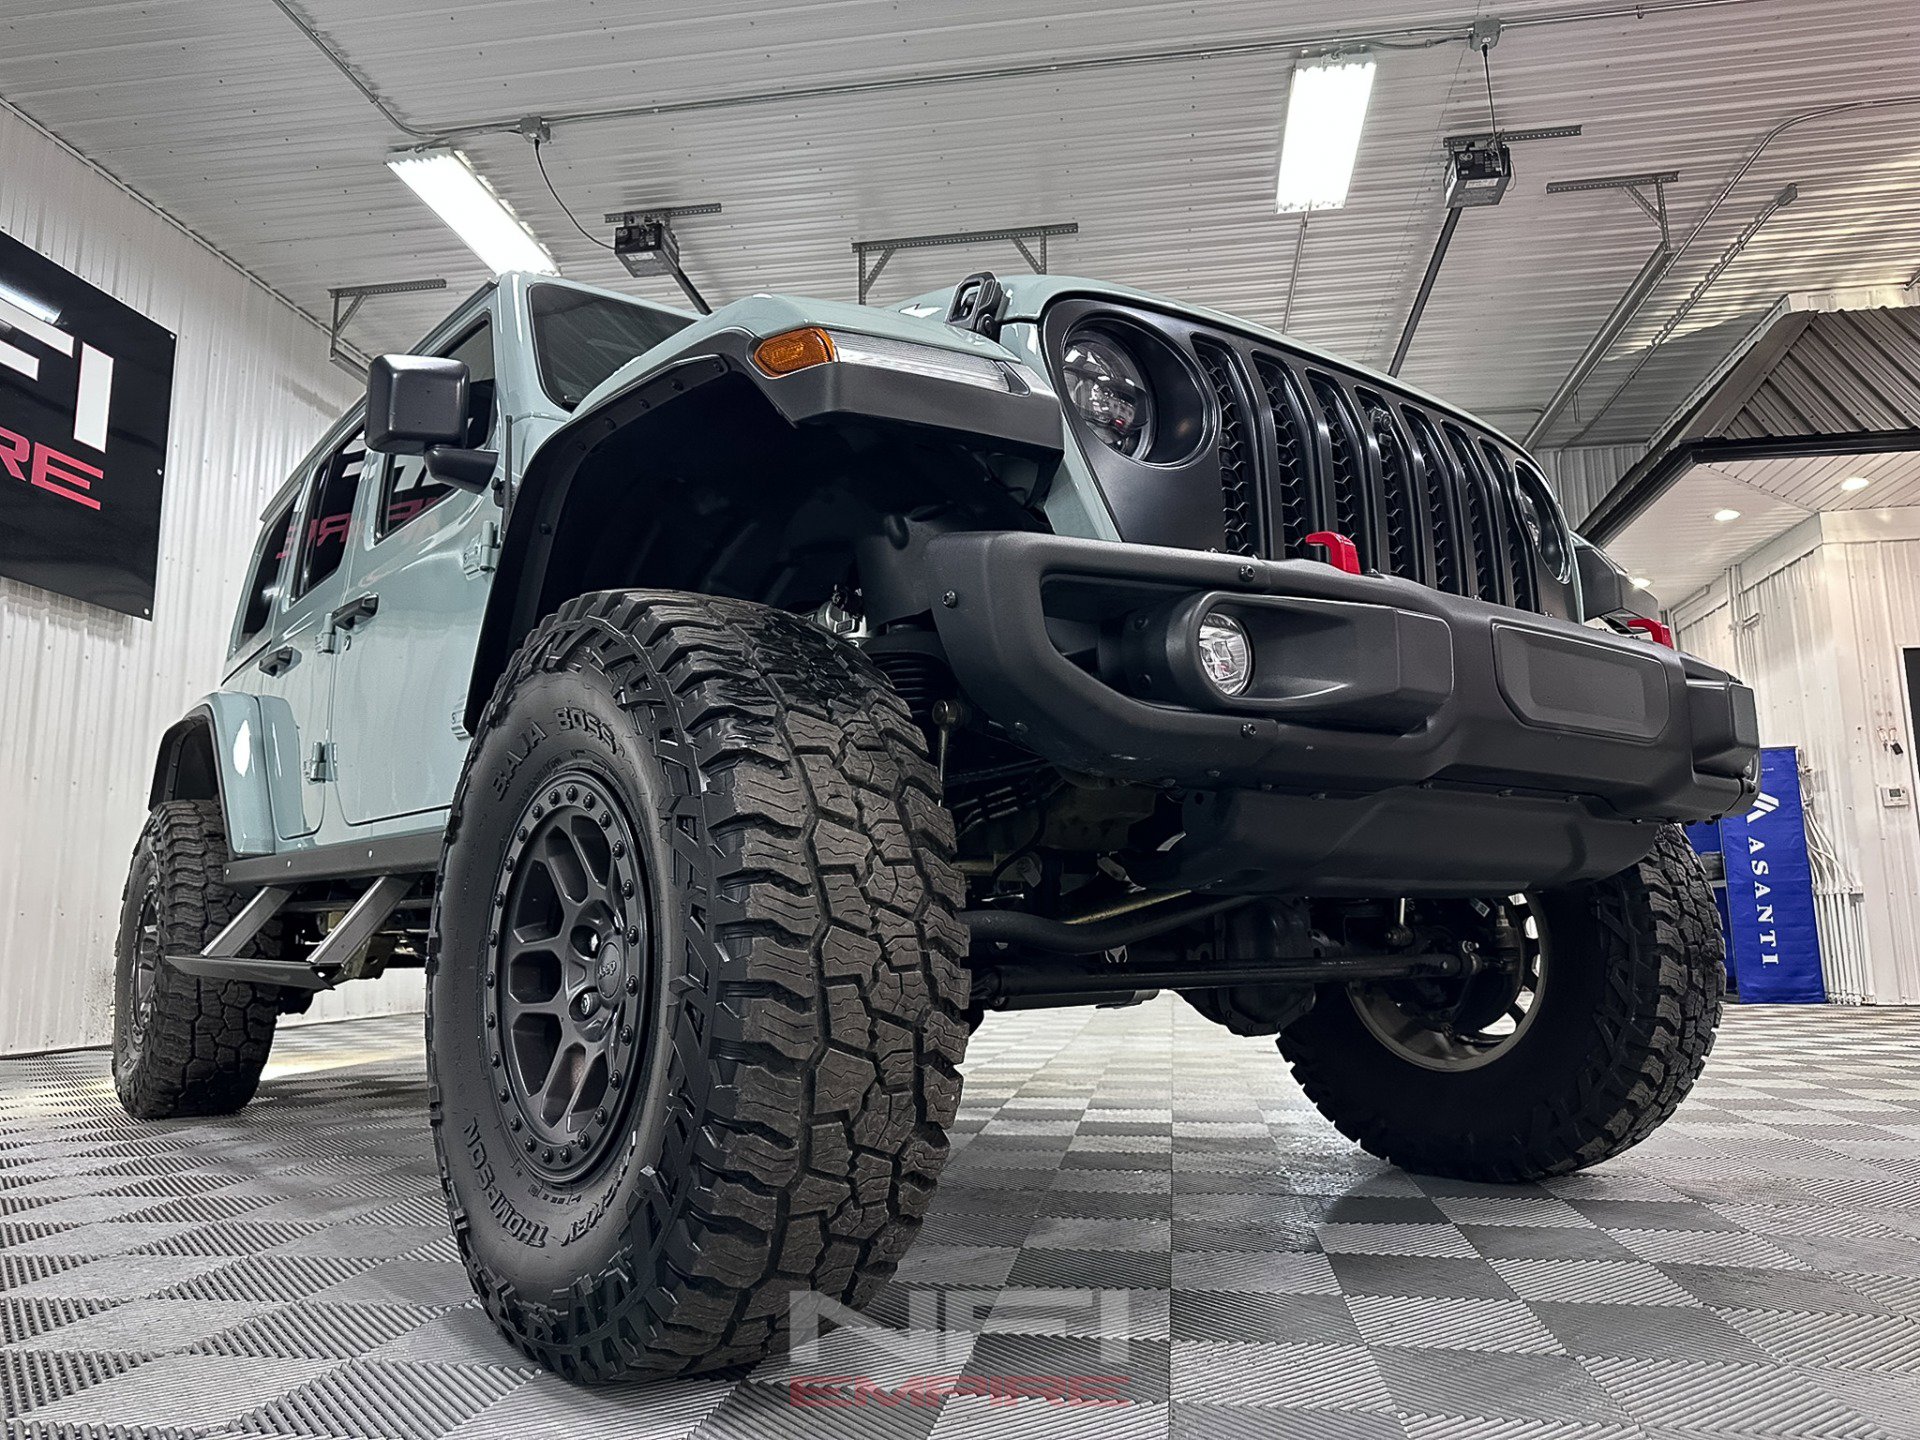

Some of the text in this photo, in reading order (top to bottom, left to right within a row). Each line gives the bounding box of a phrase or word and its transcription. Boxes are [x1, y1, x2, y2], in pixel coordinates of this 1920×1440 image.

[492, 720, 549, 802] BAJA
[553, 705, 617, 755] BOSS
[1747, 836, 1779, 965] ASANTI
